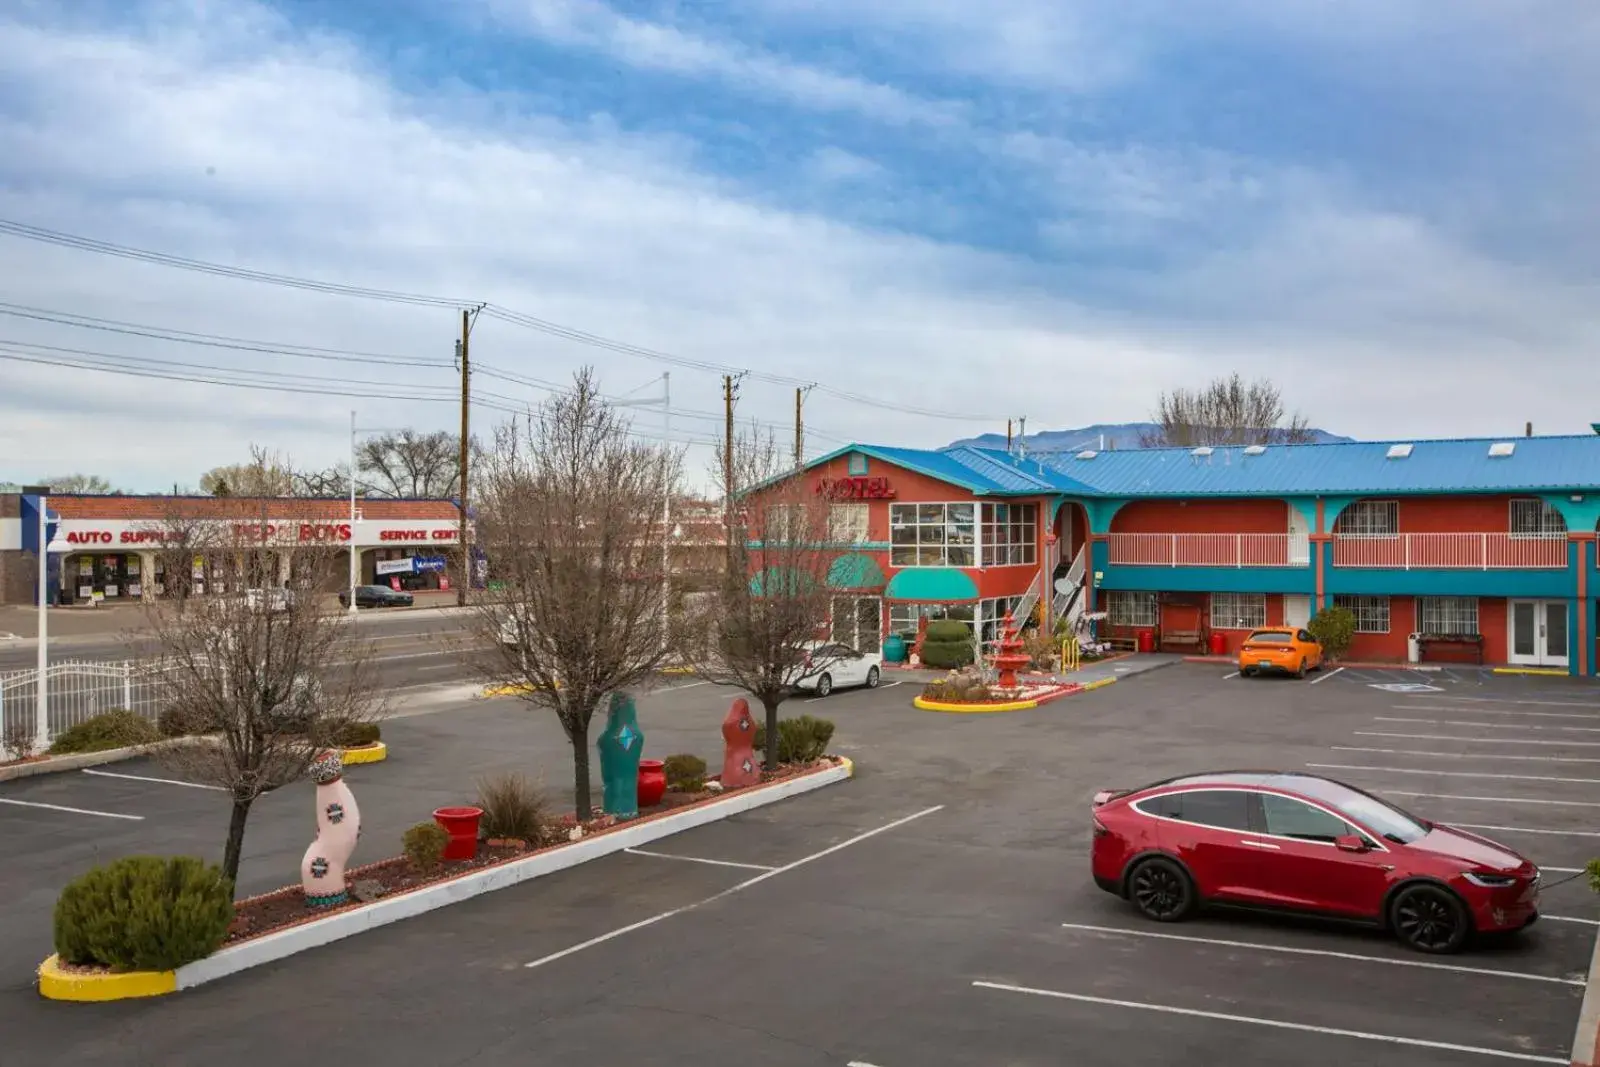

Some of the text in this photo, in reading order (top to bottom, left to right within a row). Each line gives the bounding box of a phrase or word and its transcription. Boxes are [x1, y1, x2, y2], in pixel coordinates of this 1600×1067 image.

[816, 476, 896, 499] MOTEL
[67, 531, 113, 543] AUTO
[299, 524, 351, 541] BOYS
[379, 529, 467, 541] SERVICE CENT
